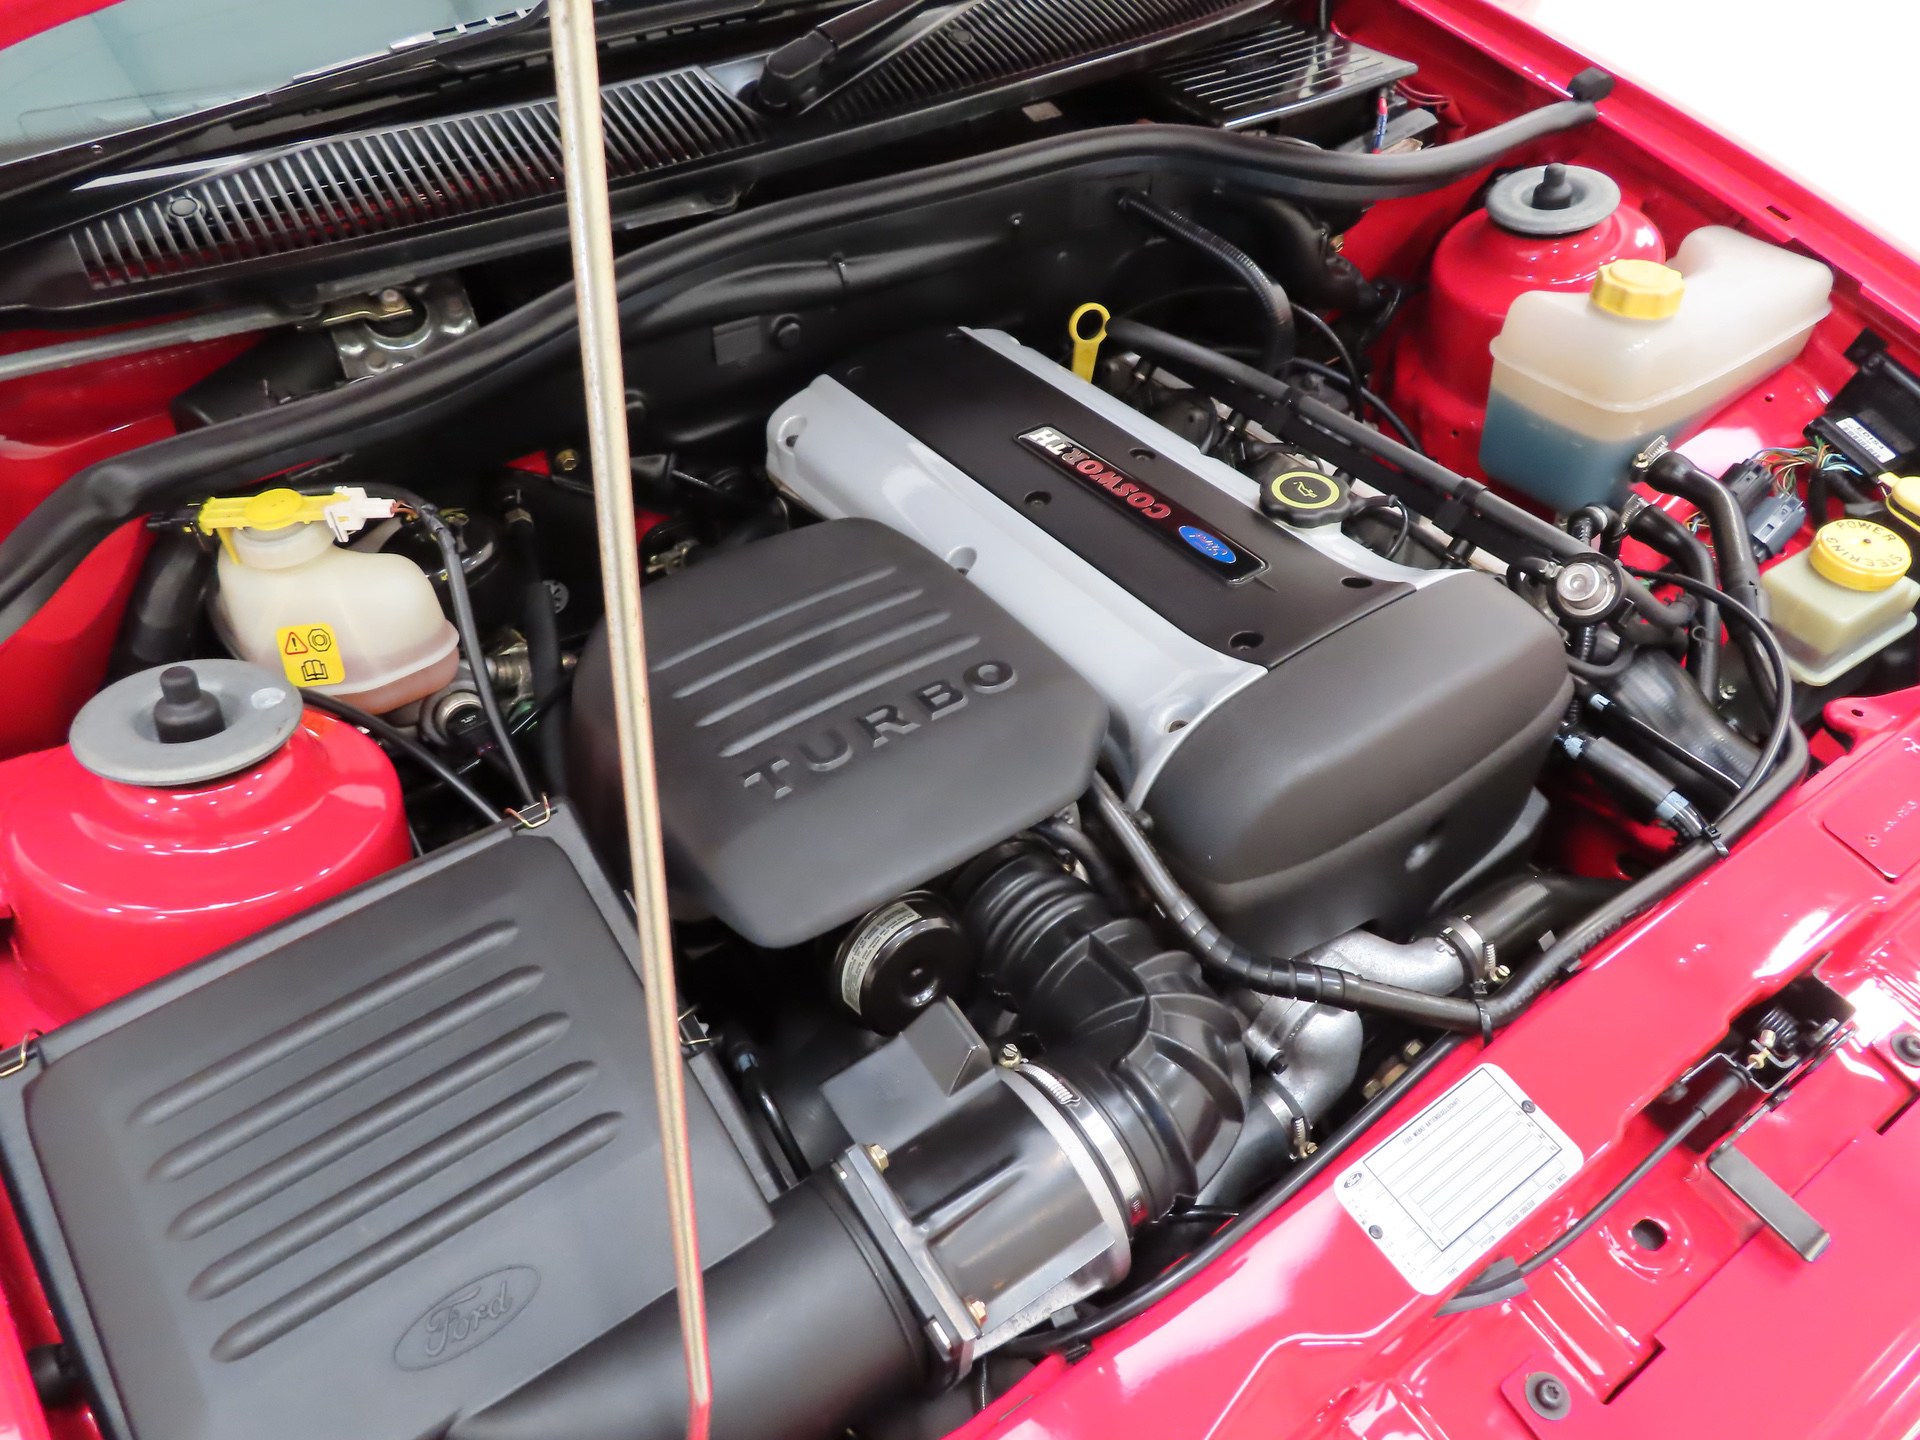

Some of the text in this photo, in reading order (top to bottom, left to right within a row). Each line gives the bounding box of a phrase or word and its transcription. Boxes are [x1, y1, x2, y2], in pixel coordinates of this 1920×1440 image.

[1030, 430, 1171, 519] COSWORTH
[1826, 536, 1903, 567] STEERING
[1837, 520, 1897, 542] POWER
[739, 660, 1019, 799] TURBO
[425, 1280, 513, 1357] Ford
